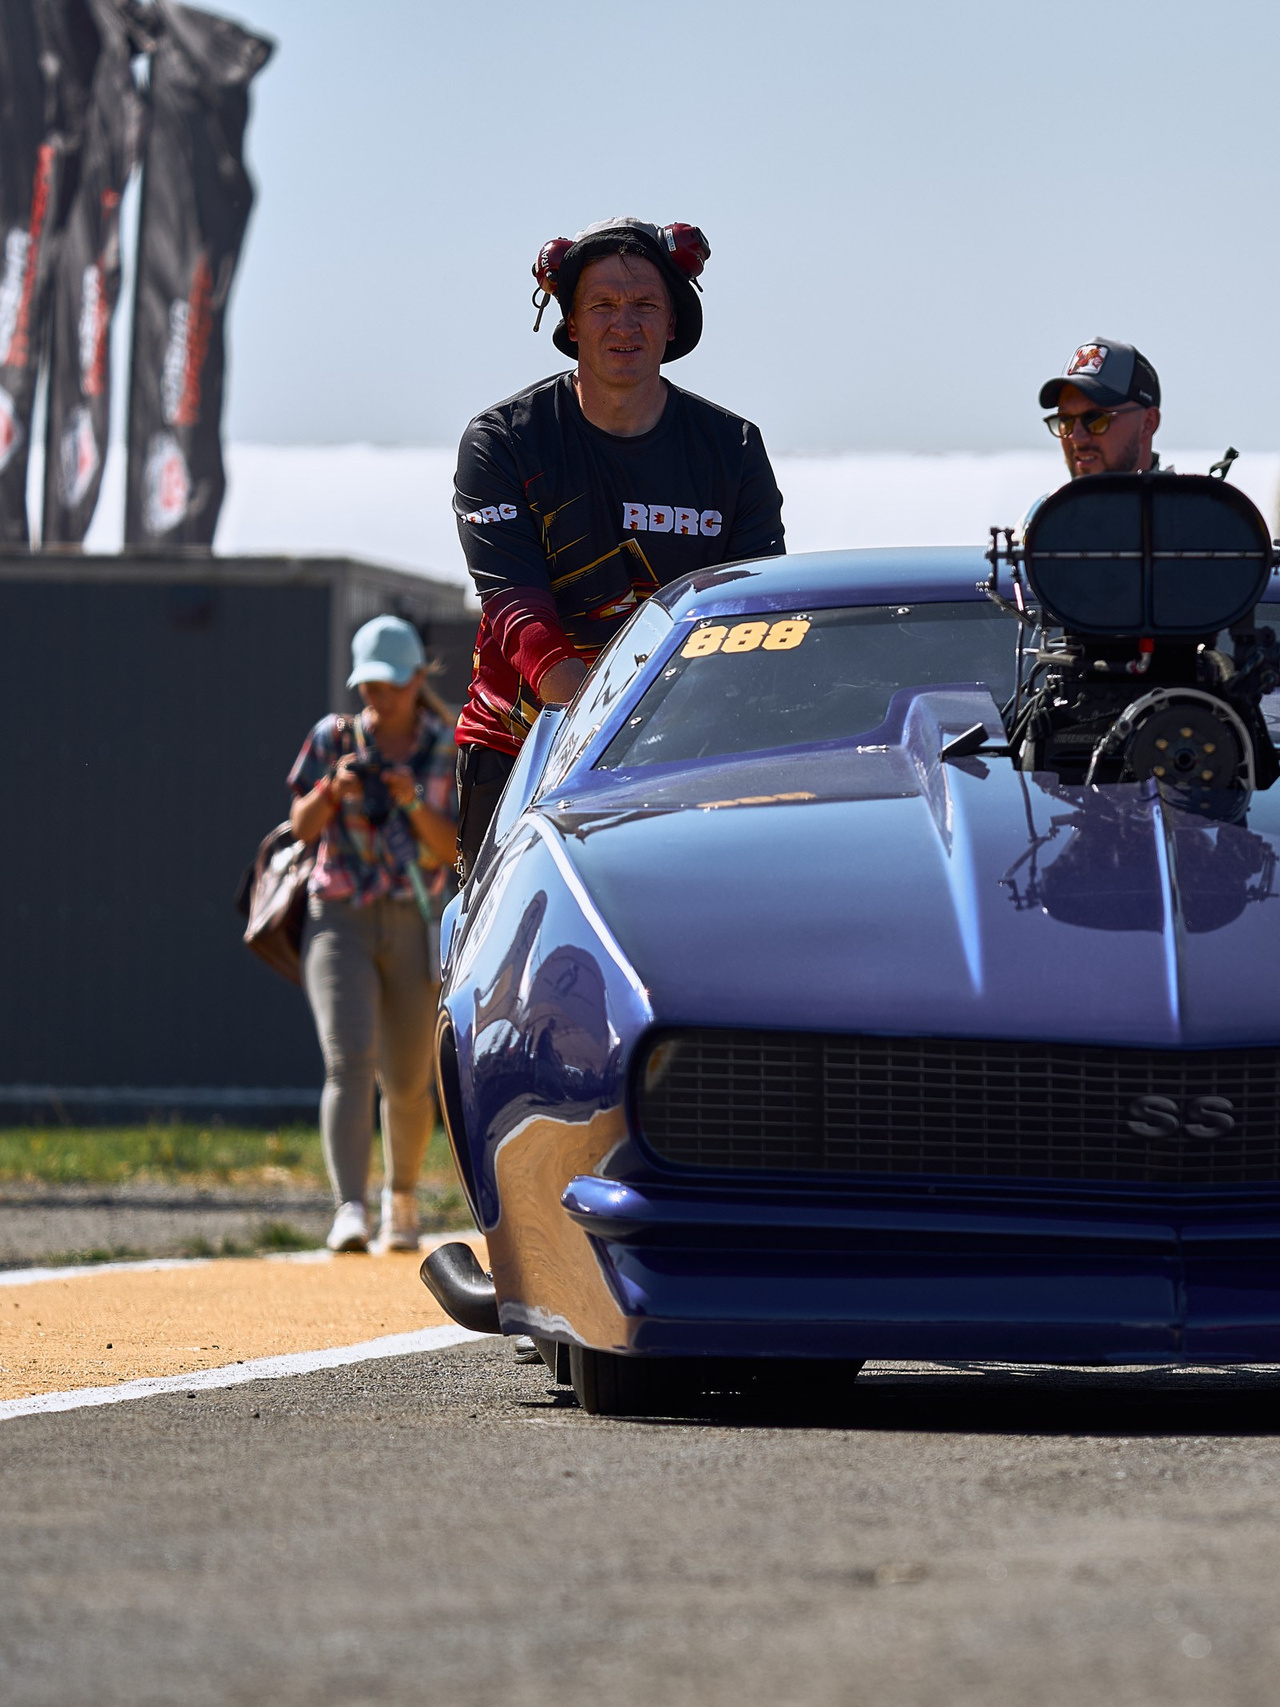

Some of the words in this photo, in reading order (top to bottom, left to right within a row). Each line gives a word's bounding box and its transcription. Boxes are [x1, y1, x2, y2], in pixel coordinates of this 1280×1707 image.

[461, 503, 518, 525] DRC
[622, 502, 723, 537] RDRC
[680, 620, 811, 659] 888
[1127, 1096, 1235, 1139] SS
